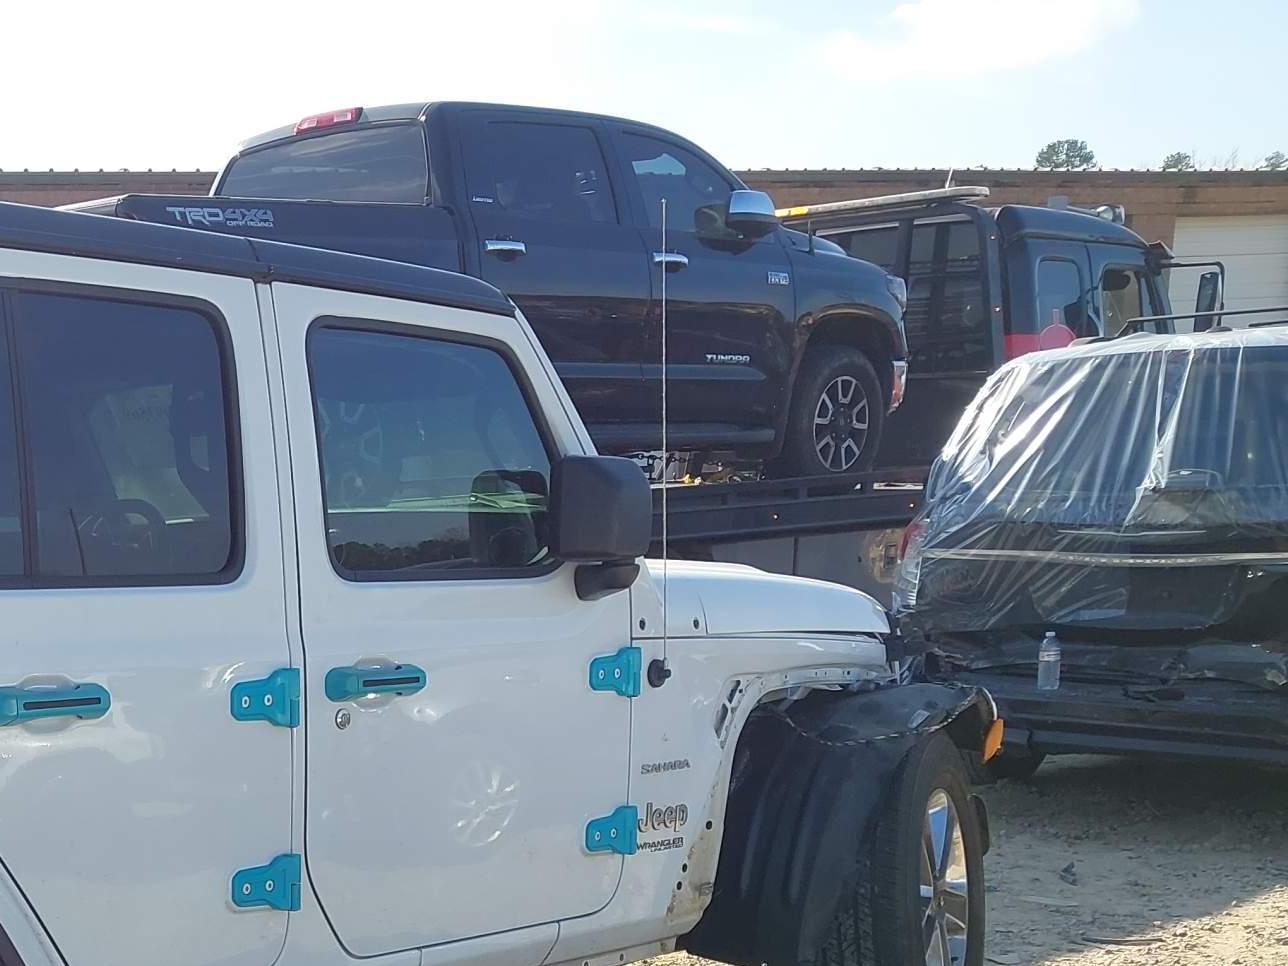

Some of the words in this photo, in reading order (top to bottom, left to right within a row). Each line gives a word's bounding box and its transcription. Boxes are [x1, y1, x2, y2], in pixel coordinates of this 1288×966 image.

[705, 354, 751, 363] TUNDRA
[640, 758, 691, 775] SAHARA
[637, 802, 688, 833] Jeep
[636, 836, 684, 850] WRANGLER
